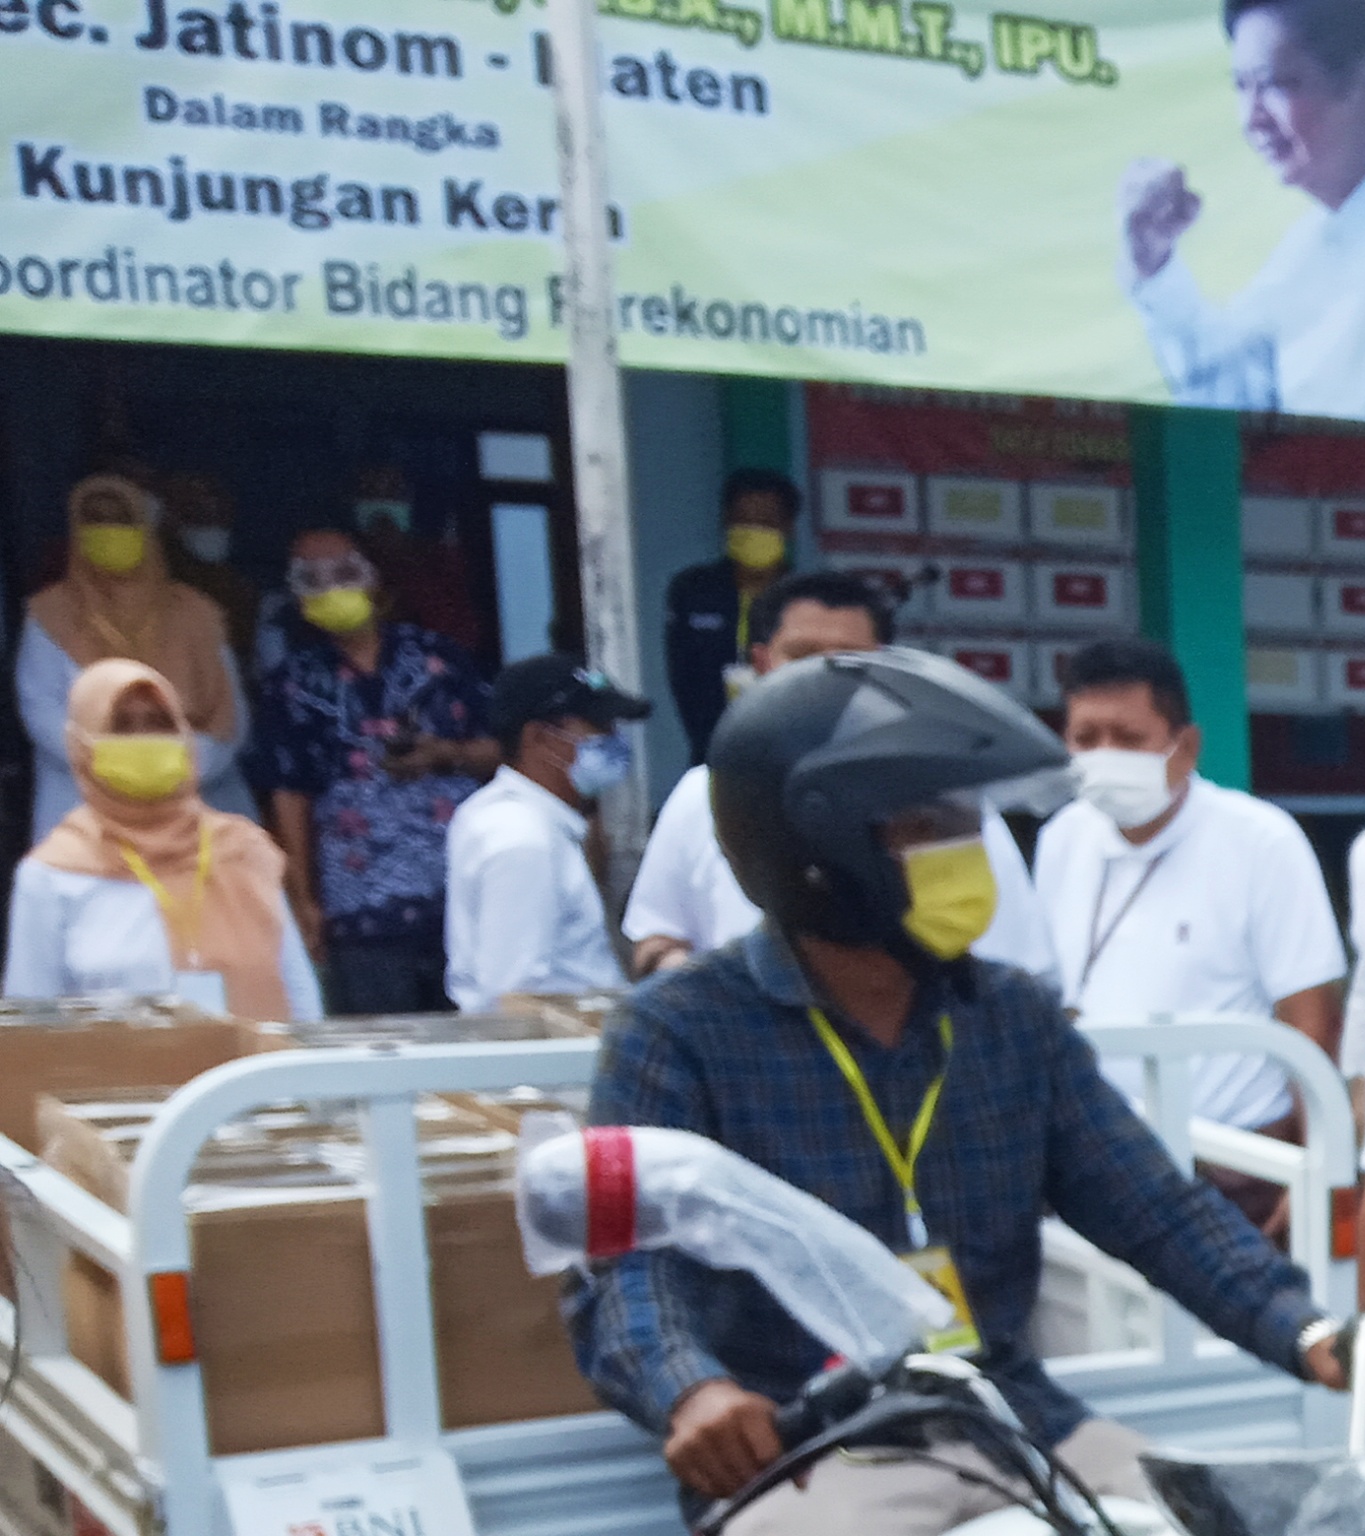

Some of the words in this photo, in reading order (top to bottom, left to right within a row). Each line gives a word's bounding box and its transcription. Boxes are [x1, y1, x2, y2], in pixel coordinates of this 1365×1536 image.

[136, 0, 461, 78] Jatinom
[533, 31, 770, 116] aten
[992, 11, 1121, 87] IPU.
[145, 85, 304, 132] Dalam
[318, 100, 499, 152] Rangka
[18, 142, 418, 230] Kunjungan
[444, 178, 624, 241] Ker
[325, 259, 530, 339] Bidang
[548, 272, 928, 355] rekonomian
